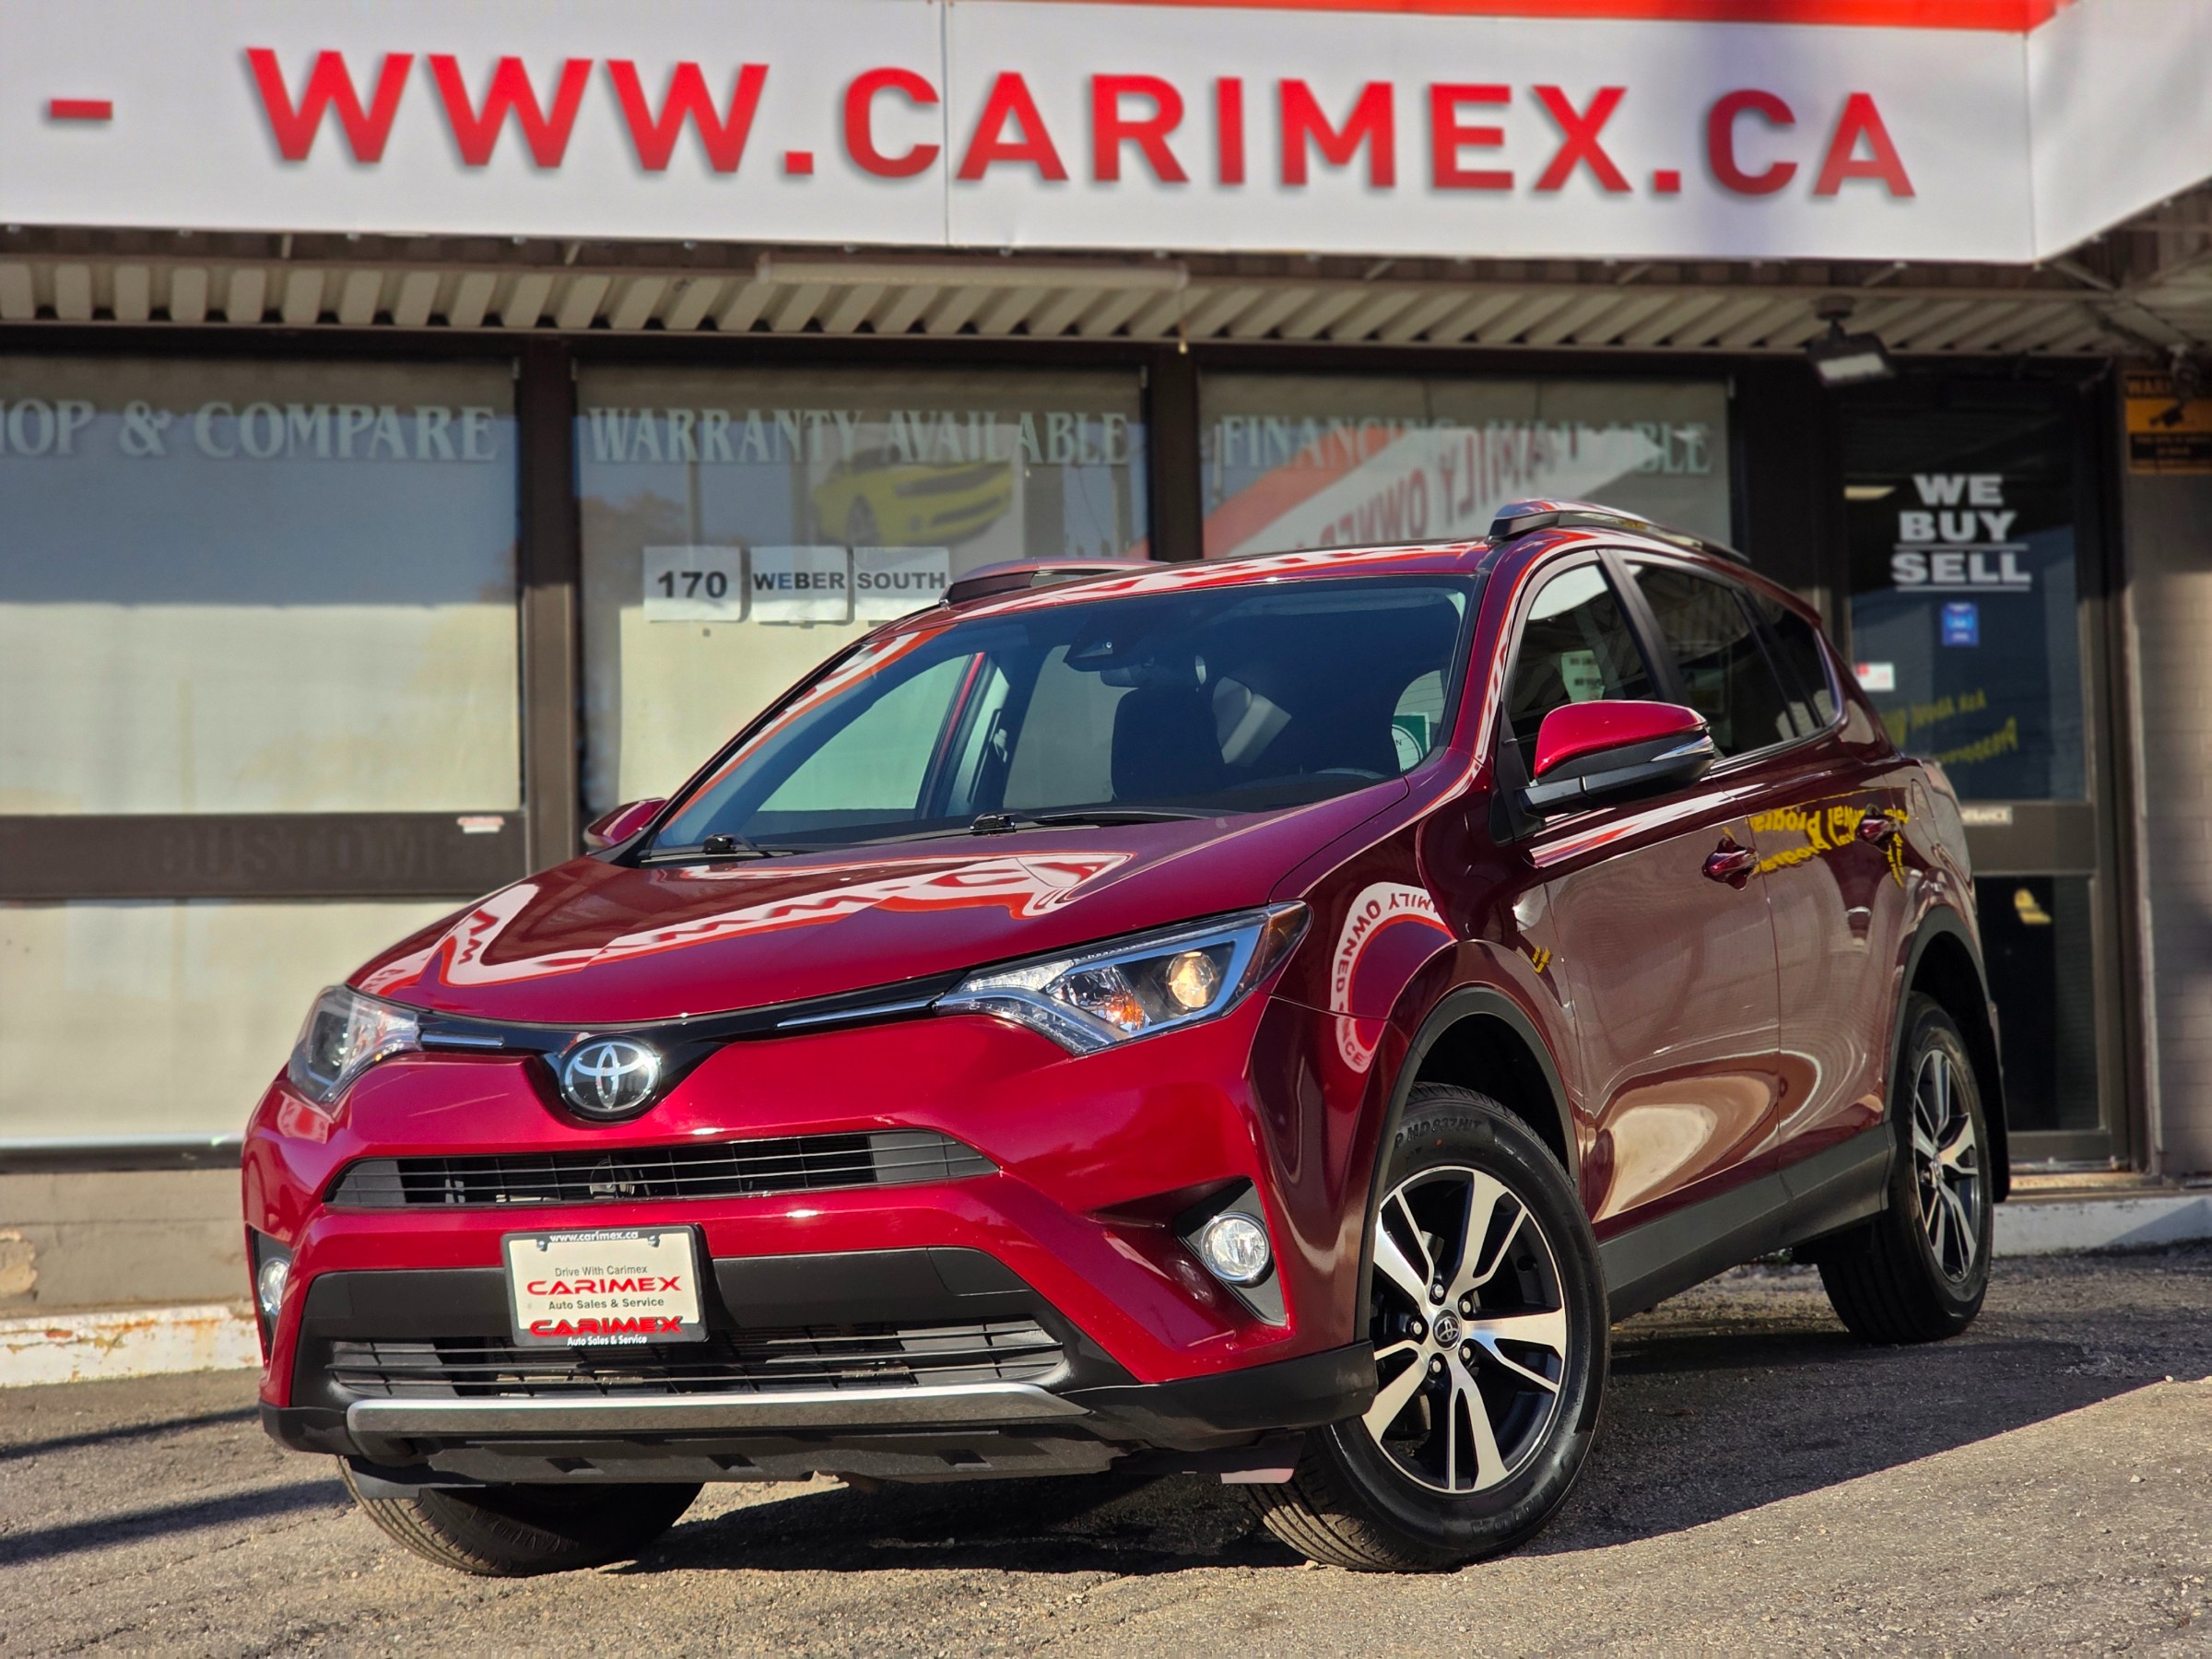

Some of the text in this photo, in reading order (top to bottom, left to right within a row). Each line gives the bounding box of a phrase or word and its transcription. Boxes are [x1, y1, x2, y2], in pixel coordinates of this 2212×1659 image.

[245, 47, 1917, 197] WWW.CARIMEX.CA
[120, 399, 172, 456] &
[194, 400, 498, 460] COMPARE
[588, 407, 1129, 465] WARRANTY AVAILABLE
[1221, 417, 1458, 469] FINANC
[1912, 474, 2005, 506] WE
[1899, 511, 2018, 543] BUY
[1890, 551, 2033, 584] SELL
[655, 570, 947, 600] 170 WEBER SOUTH
[549, 1231, 639, 1242] www.carimex.ca
[526, 1276, 682, 1296] CARIMEX
[555, 1265, 648, 1277] Drive With Carimex
[548, 1297, 665, 1311] Auto Sales & Service
[529, 1315, 684, 1336] CARIMEX
[567, 1334, 647, 1347] Auto Sales & Service
